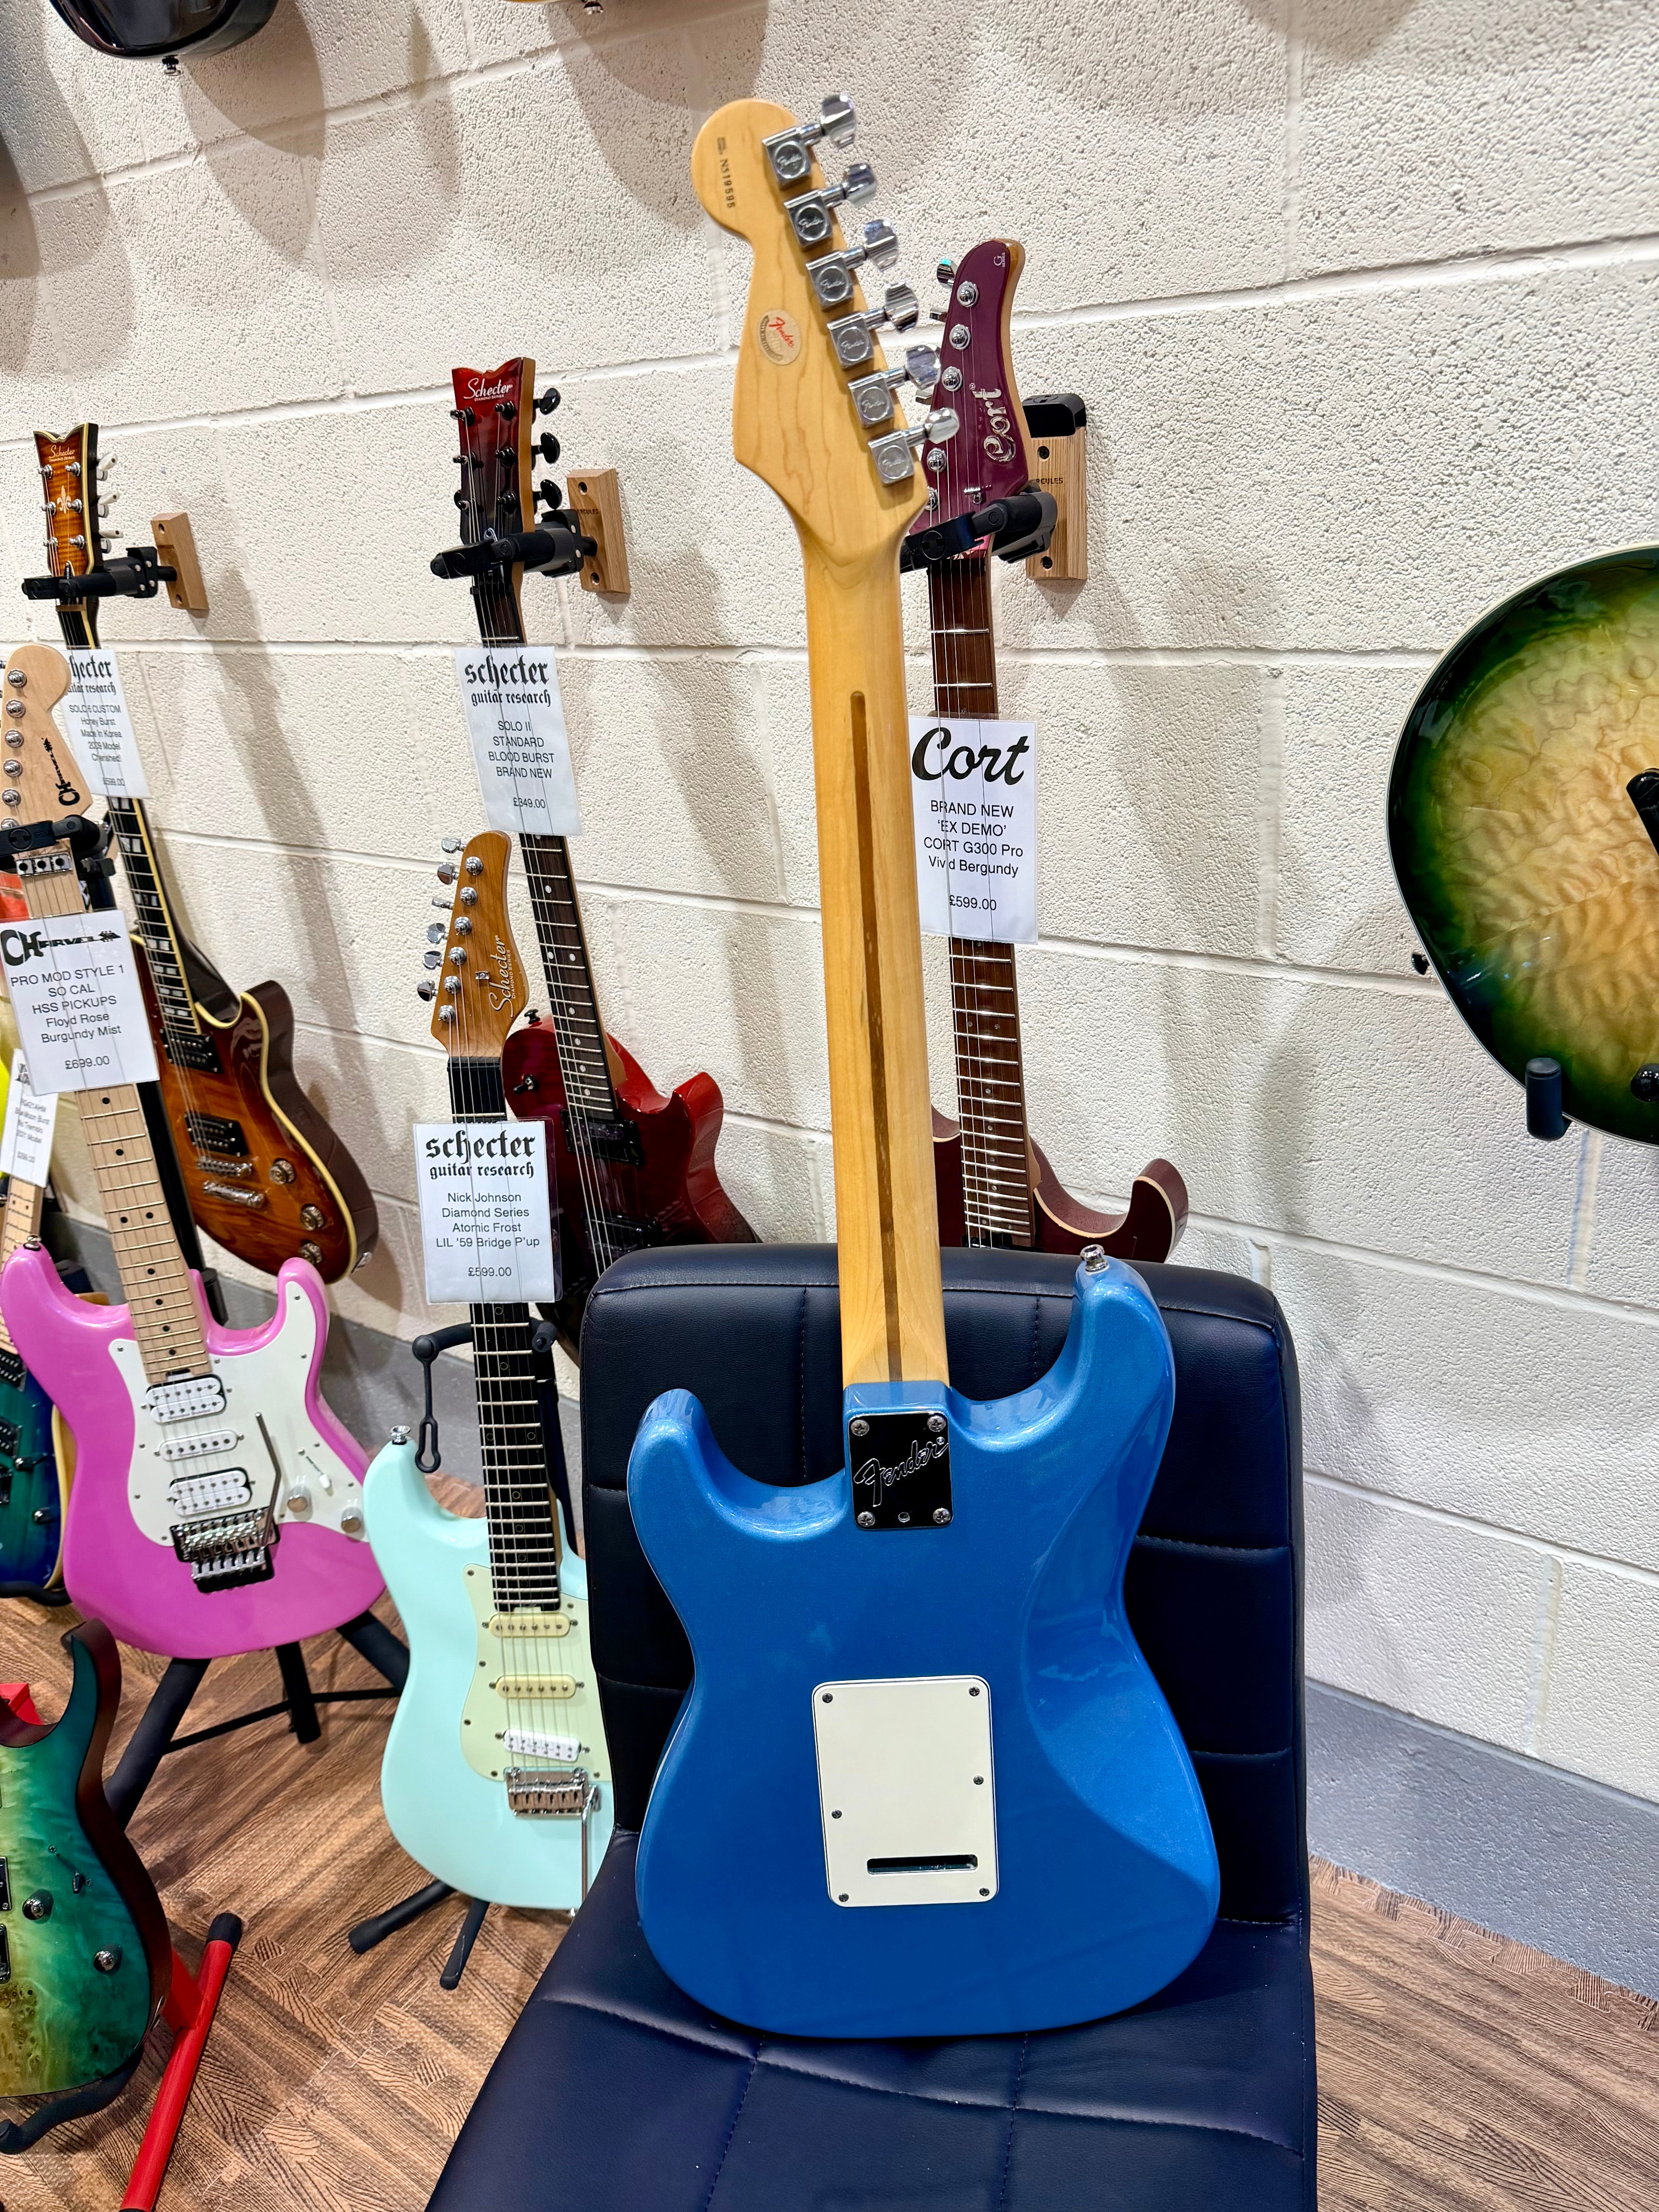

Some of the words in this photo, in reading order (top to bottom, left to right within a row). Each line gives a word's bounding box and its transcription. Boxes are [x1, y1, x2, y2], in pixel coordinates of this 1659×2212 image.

[463, 378, 513, 399] Schecter
[49, 445, 75, 458] Schecter
[69, 655, 112, 682] hecter
[465, 655, 549, 689] schecter
[86, 682, 116, 696] research
[471, 689, 503, 706] guitar
[506, 689, 551, 707] research
[93, 705, 122, 713] CUSTOM
[498, 721, 522, 731] SOLO
[104, 730, 123, 738] Korea
[493, 736, 544, 747] STANDARD
[488, 751, 520, 762] BLOOD
[522, 752, 555, 763] BURST
[912, 727, 1030, 785] Cort
[496, 766, 527, 778] BRAND
[530, 768, 552, 778] NEW
[931, 800, 976, 816] BRAND
[981, 804, 1014, 818] NEW
[924, 836, 959, 852] CORT
[963, 841, 997, 855] G300
[1001, 844, 1023, 857] Pro
[929, 855, 955, 870] Vivd
[959, 859, 1018, 878] Bergundy
[949, 895, 997, 910] £599.00
[10, 975, 38, 987] PRO
[41, 971, 71, 983] MOD
[75, 965, 115, 979] STYLE
[118, 964, 124, 974] 1
[489, 937, 514, 1018] Schecter
[48, 987, 67, 997] SO
[70, 983, 95, 995] CAL
[32, 1003, 58, 1014] HSS
[62, 995, 117, 1011] PICKUPS
[46, 1015, 77, 1028] Floyd
[80, 1013, 110, 1024] Rose
[41, 1029, 94, 1043] Burgundy
[98, 1025, 122, 1036] Mist
[65, 1056, 110, 1070] £699.00
[426, 1130, 535, 1164] schecter
[430, 1163, 472, 1180] guitar
[477, 1161, 534, 1179] research
[448, 1193, 472, 1202] Nick
[475, 1193, 521, 1202] Johnson
[442, 1208, 490, 1217] Diamond
[494, 1207, 529, 1217] Series
[452, 1223, 490, 1232] Atomic
[493, 1223, 522, 1232] Frost
[436, 1238, 453, 1247] LIL
[477, 1238, 511, 1249] Bridge
[468, 1267, 512, 1277] £599.00
[853, 1439, 950, 1508] Fender
